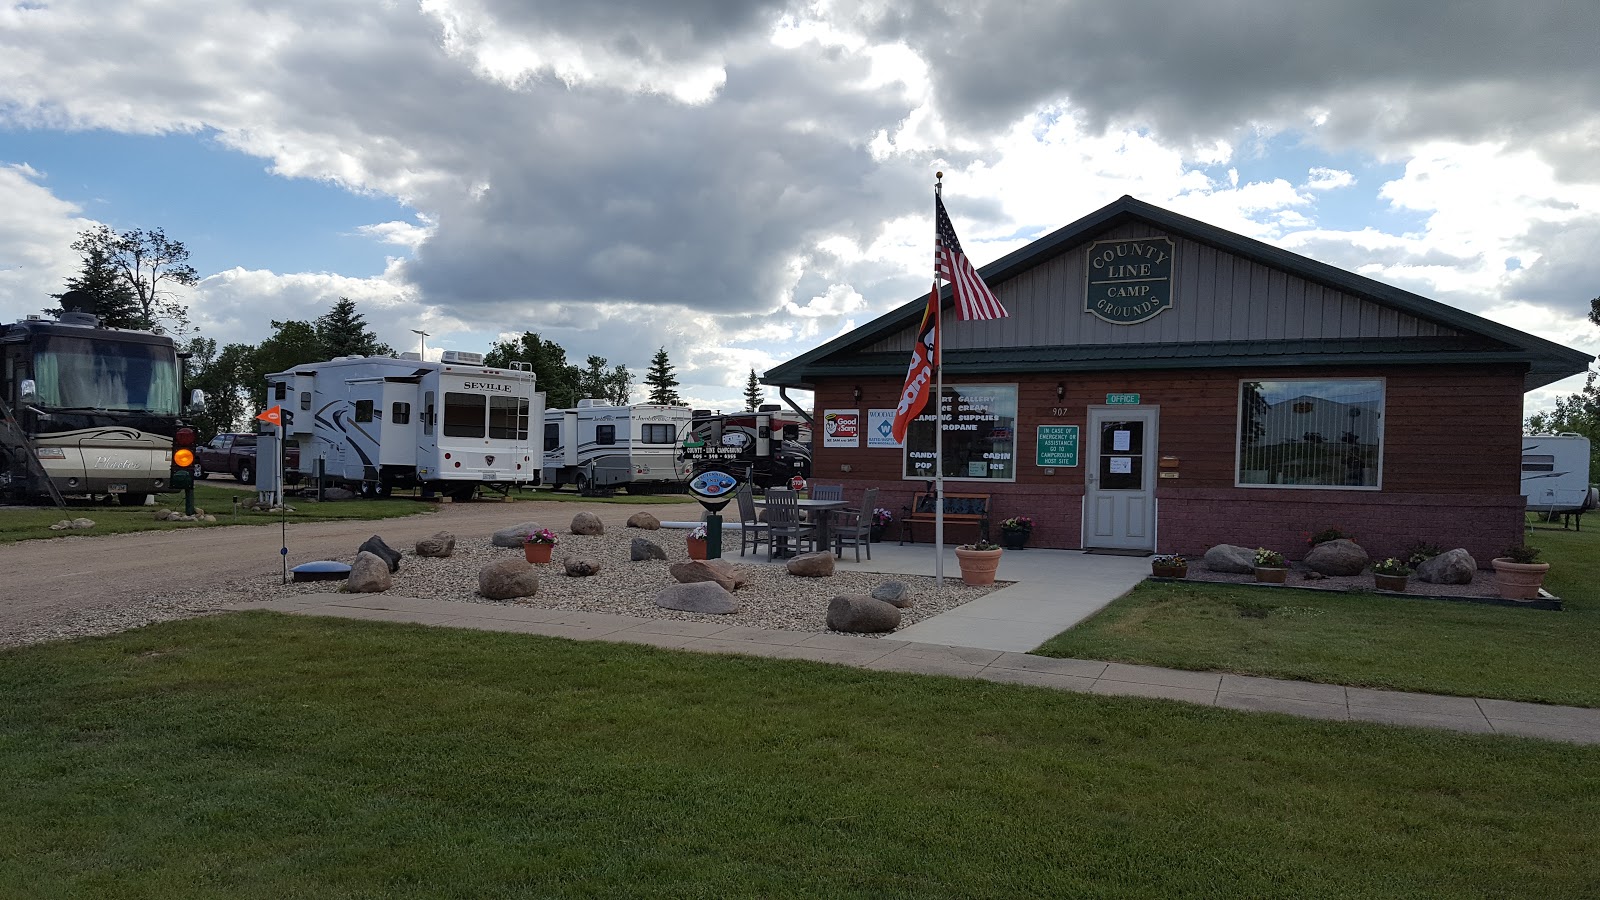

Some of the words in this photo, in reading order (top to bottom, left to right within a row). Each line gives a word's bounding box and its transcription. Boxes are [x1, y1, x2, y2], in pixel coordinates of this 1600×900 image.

[1093, 243, 1169, 268] COUNTY
[1108, 264, 1151, 278] LINE
[1107, 286, 1150, 297] CAMP
[1097, 295, 1160, 317] GROUNDS
[464, 381, 512, 393] SEVILLE
[1111, 395, 1135, 403] OFFICE
[1052, 407, 1067, 416] 907
[958, 414, 1000, 422] SUPPLIES
[881, 425, 891, 433] W
[909, 451, 937, 459] CANDY
[983, 452, 1011, 460] CABIN
